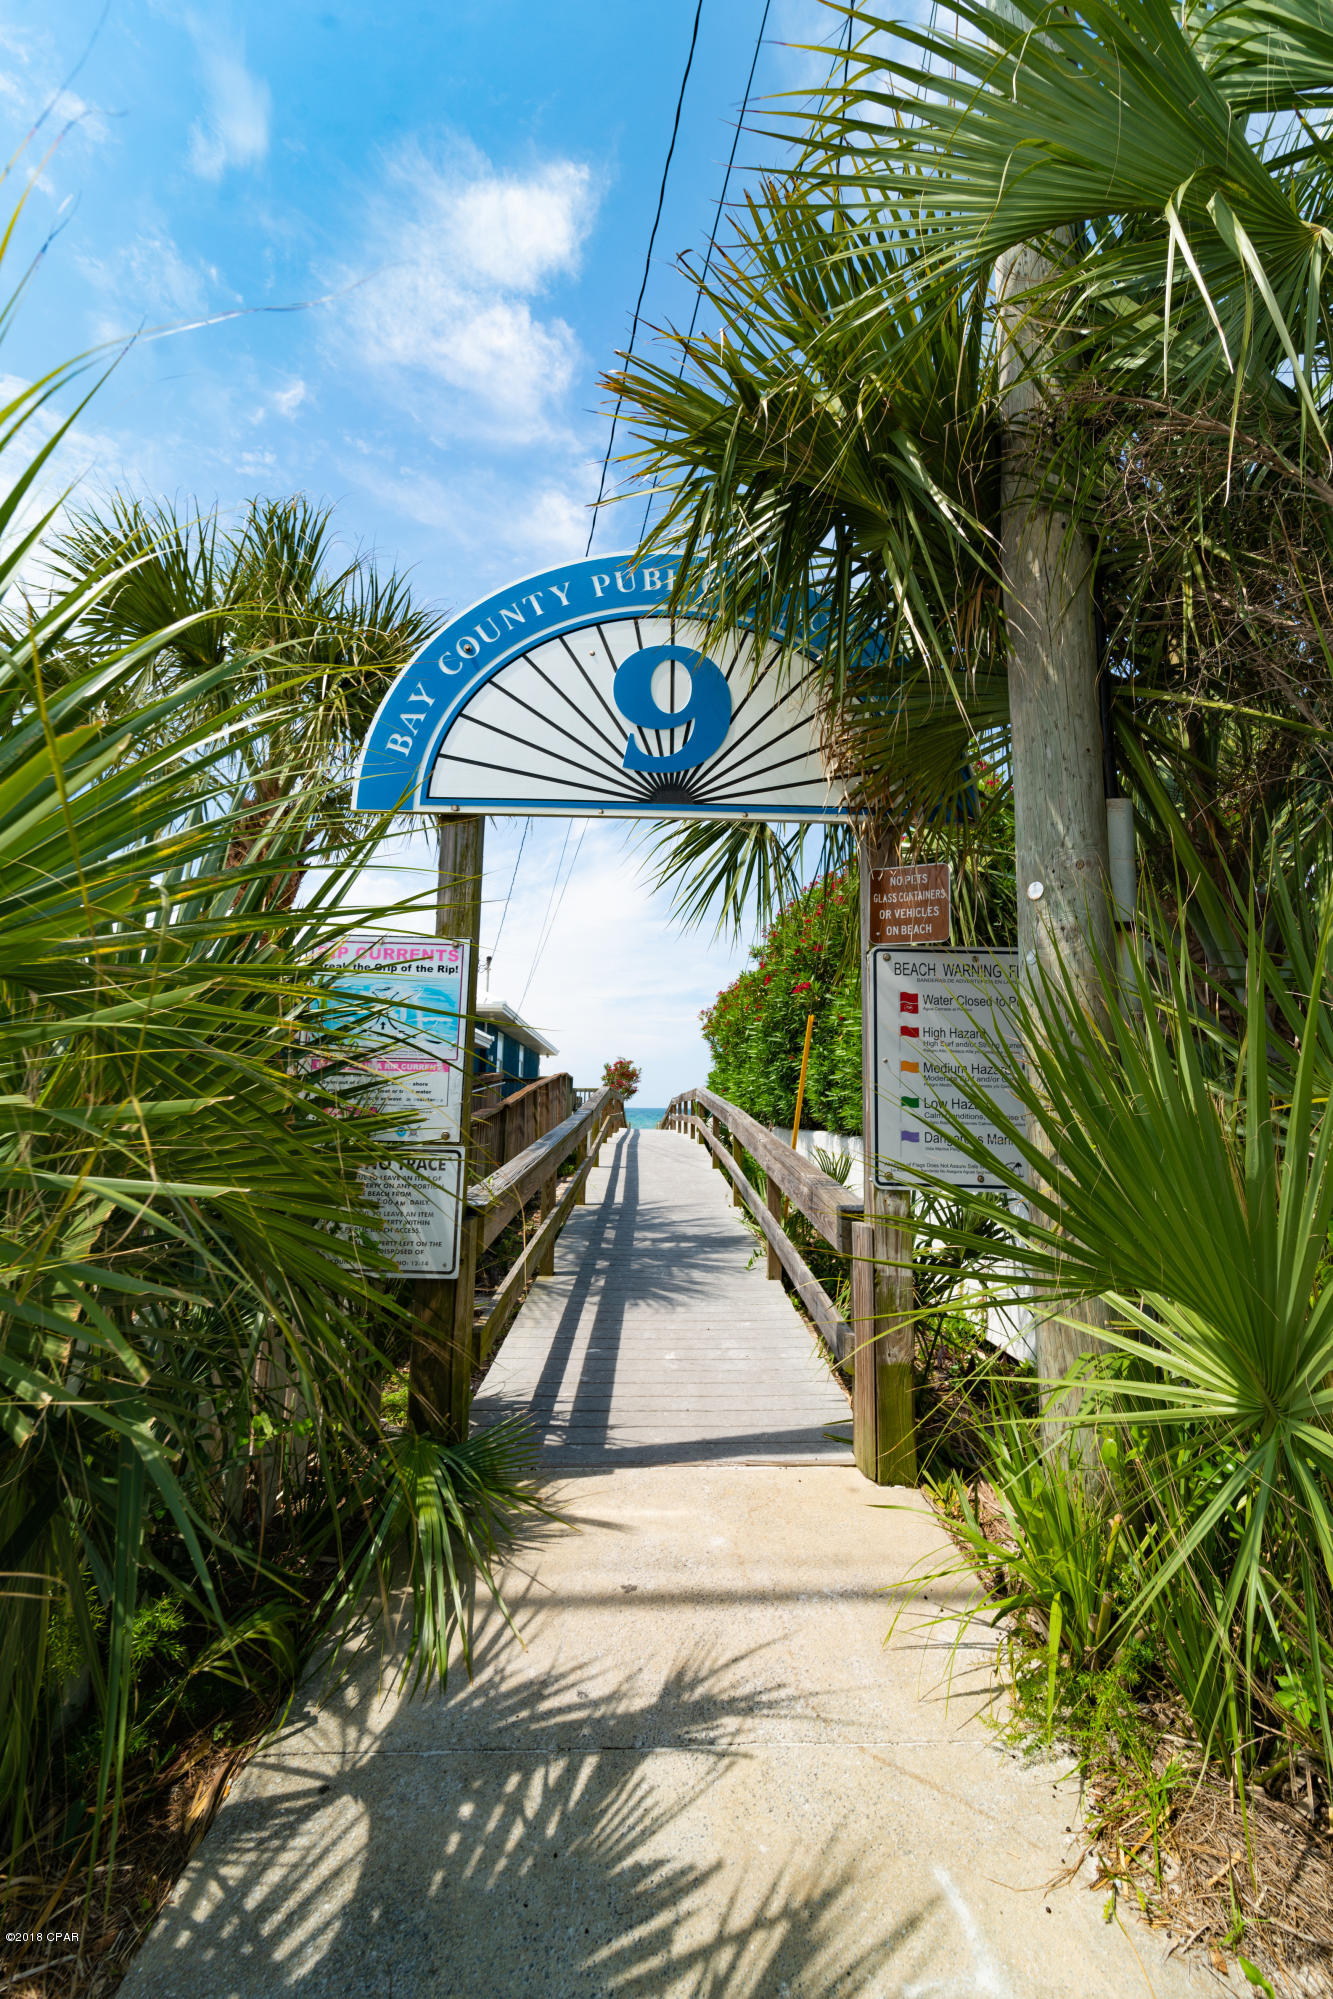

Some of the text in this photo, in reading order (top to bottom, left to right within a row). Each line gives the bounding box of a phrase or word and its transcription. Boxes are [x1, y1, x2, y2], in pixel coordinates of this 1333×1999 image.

[385, 681, 436, 757] BAY
[438, 581, 571, 675] COUNTY
[613, 644, 732, 772] 9
[890, 873, 928, 886] NO PETS
[873, 889, 945, 903] GLASS CONTAINERS
[879, 907, 940, 919] OR VEHICLES
[886, 923, 932, 936] ON BEACH
[355, 947, 459, 963] CURRENTS
[401, 965, 412, 973] of
[416, 965, 434, 973] the
[438, 965, 459, 975] Rip!
[894, 962, 936, 976] BEACH
[943, 962, 1002, 978] WARNING
[923, 994, 953, 1006] Water
[957, 995, 992, 1007] Closed
[996, 996, 1005, 1007] to
[923, 1027, 946, 1040] High
[924, 1040, 939, 1048] High
[924, 1062, 968, 1074] Medium
[976, 1075, 1000, 1083] and/or
[924, 1098, 948, 1109] Low
